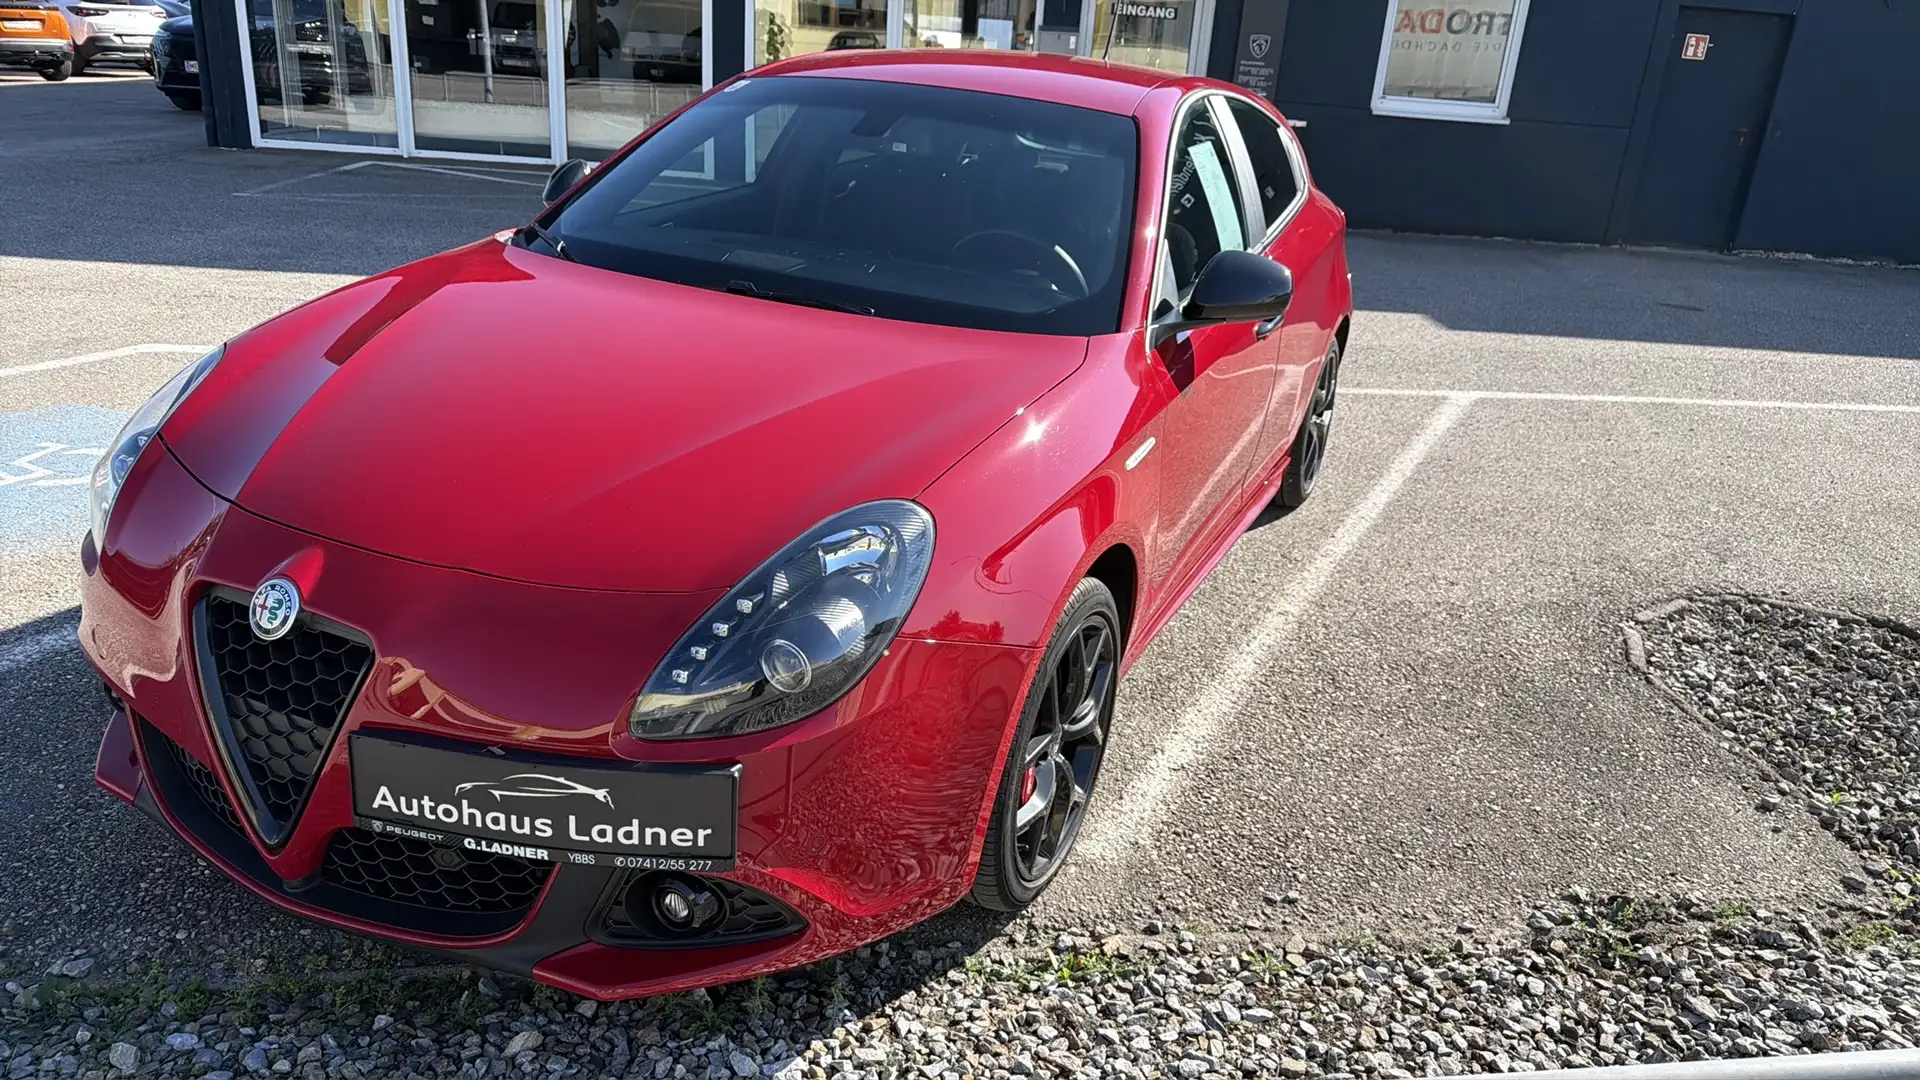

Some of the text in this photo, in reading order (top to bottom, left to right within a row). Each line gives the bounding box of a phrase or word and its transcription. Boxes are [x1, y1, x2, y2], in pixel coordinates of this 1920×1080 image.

[1114, 4, 1176, 19] EINGANG
[275, 585, 291, 616] ROMEO
[372, 785, 712, 847] Autohaus Ladner
[386, 825, 712, 871] PEUGEOT G.LADNER YBBS 07412/55 277
